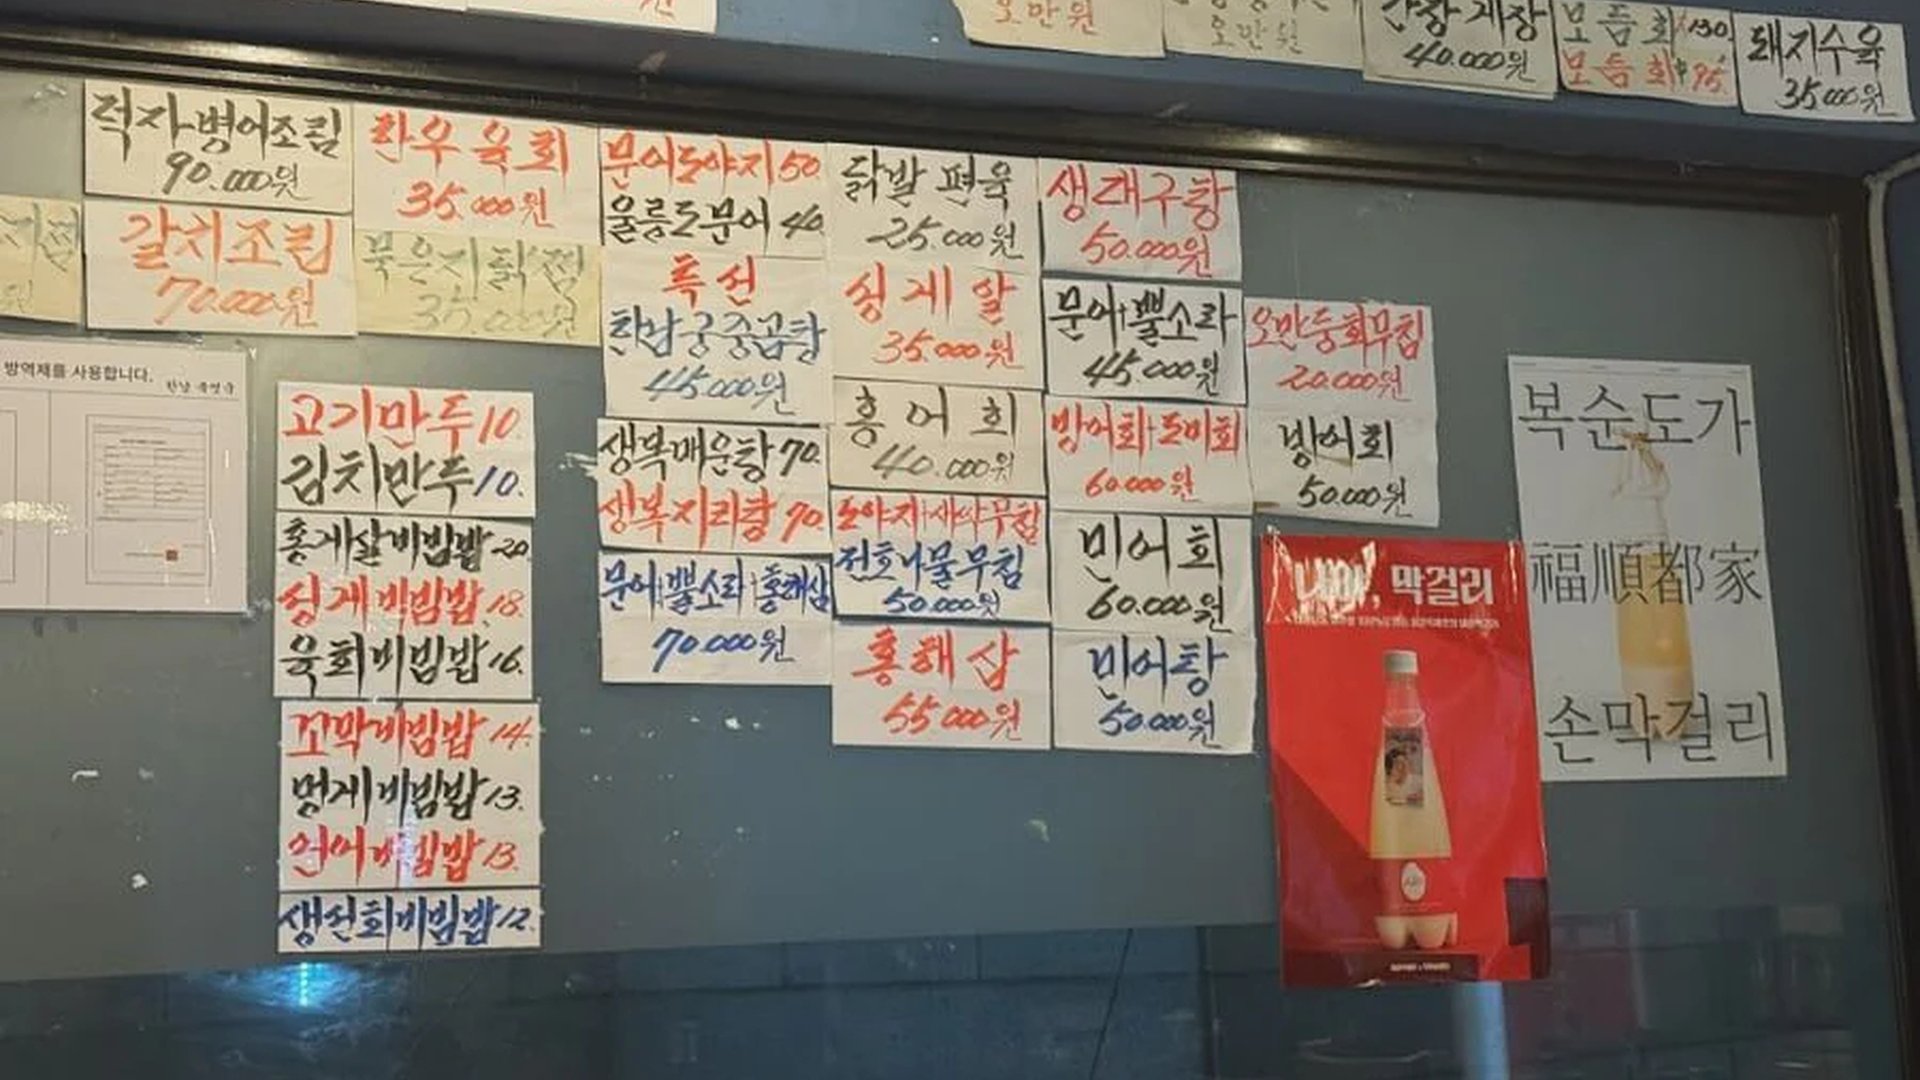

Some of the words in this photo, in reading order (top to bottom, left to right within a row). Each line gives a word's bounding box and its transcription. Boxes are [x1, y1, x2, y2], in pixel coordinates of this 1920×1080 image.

[119, 206, 334, 283] 갈치조림
[281, 387, 474, 454] 고기만두
[1518, 381, 1752, 456] 복순도가
[280, 442, 475, 510] 김치만두
[1390, 563, 1496, 607] 막걸리
[1530, 540, 1763, 606] 福順都家
[1544, 691, 1775, 764] 손막걸리
